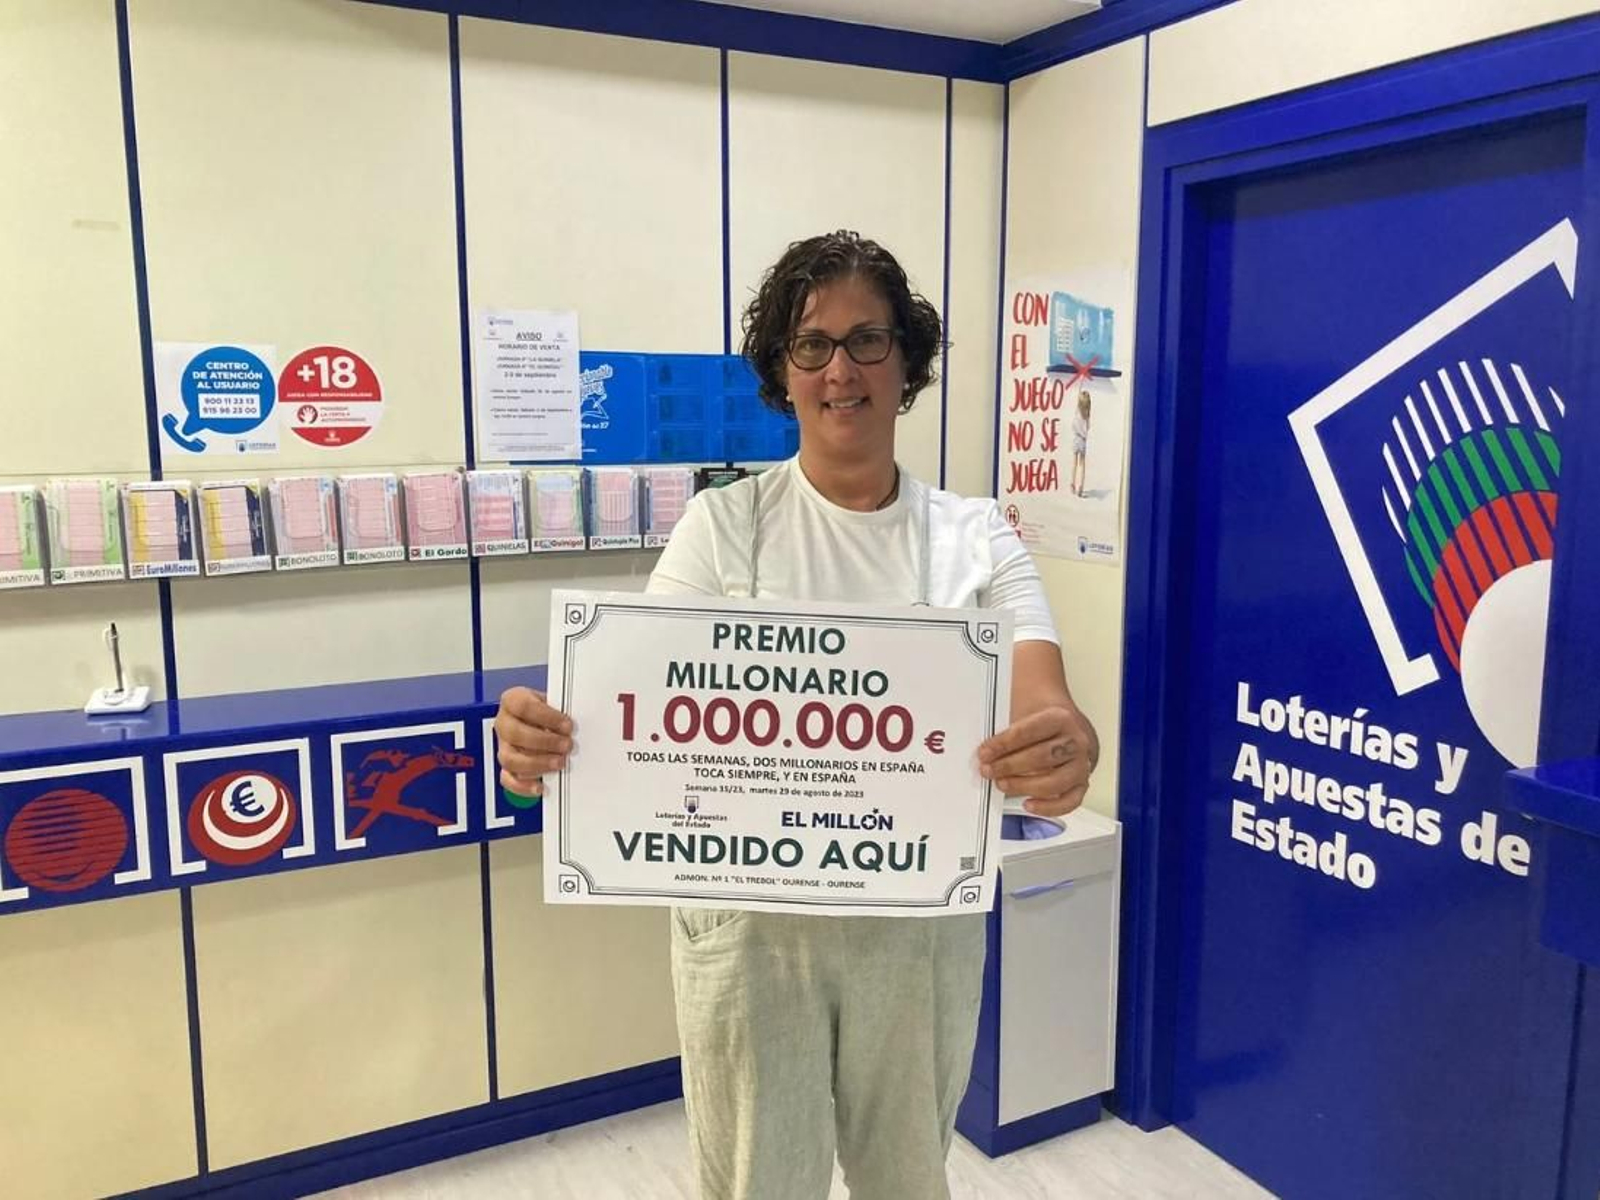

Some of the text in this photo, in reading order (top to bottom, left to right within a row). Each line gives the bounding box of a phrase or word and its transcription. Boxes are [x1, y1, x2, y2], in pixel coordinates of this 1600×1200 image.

[1013, 292, 1048, 327] CON
[515, 331, 542, 341] AVISO
[1011, 334, 1029, 370] EL
[192, 370, 263, 380] DE ATENCIÓN
[205, 361, 250, 370] CENTRO
[297, 355, 357, 389] +18
[197, 381, 260, 389] AL USUARIO
[1009, 377, 1064, 412] JUEGO
[1008, 417, 1060, 453] NO SE
[1006, 458, 1058, 493] JUEGA
[290, 553, 338, 566] BONOLOTO
[359, 550, 403, 562] BONOLOTO
[425, 547, 467, 557] El Gordo
[73, 567, 124, 579] PRIMITIVA
[146, 563, 198, 575] EuroMillones
[713, 622, 845, 655] PREMIO
[666, 661, 889, 697] MILLONARIO
[617, 693, 946, 754] 1.000.000 €
[1236, 681, 1469, 794] Loterías y
[627, 752, 925, 773] TODAS LAS SEMANAS, DOS MILLONARIOS EN ESPAÑA
[694, 768, 856, 784] TOCA SIEMPRE, Y EN ESPAÑA
[685, 784, 717, 793] Semana
[749, 786, 777, 794] martes
[791, 788, 801, 796] de
[803, 789, 830, 798] agosto
[844, 790, 864, 798] 2023
[693, 813, 727, 822] Apuestas
[1232, 742, 1531, 877] Apuestas de
[781, 811, 807, 828] EL
[613, 831, 930, 873] VENDIDO AQUÍ
[1231, 799, 1376, 889] Estado
[782, 878, 819, 887] OURENSE
[827, 880, 865, 889] OURENSE
